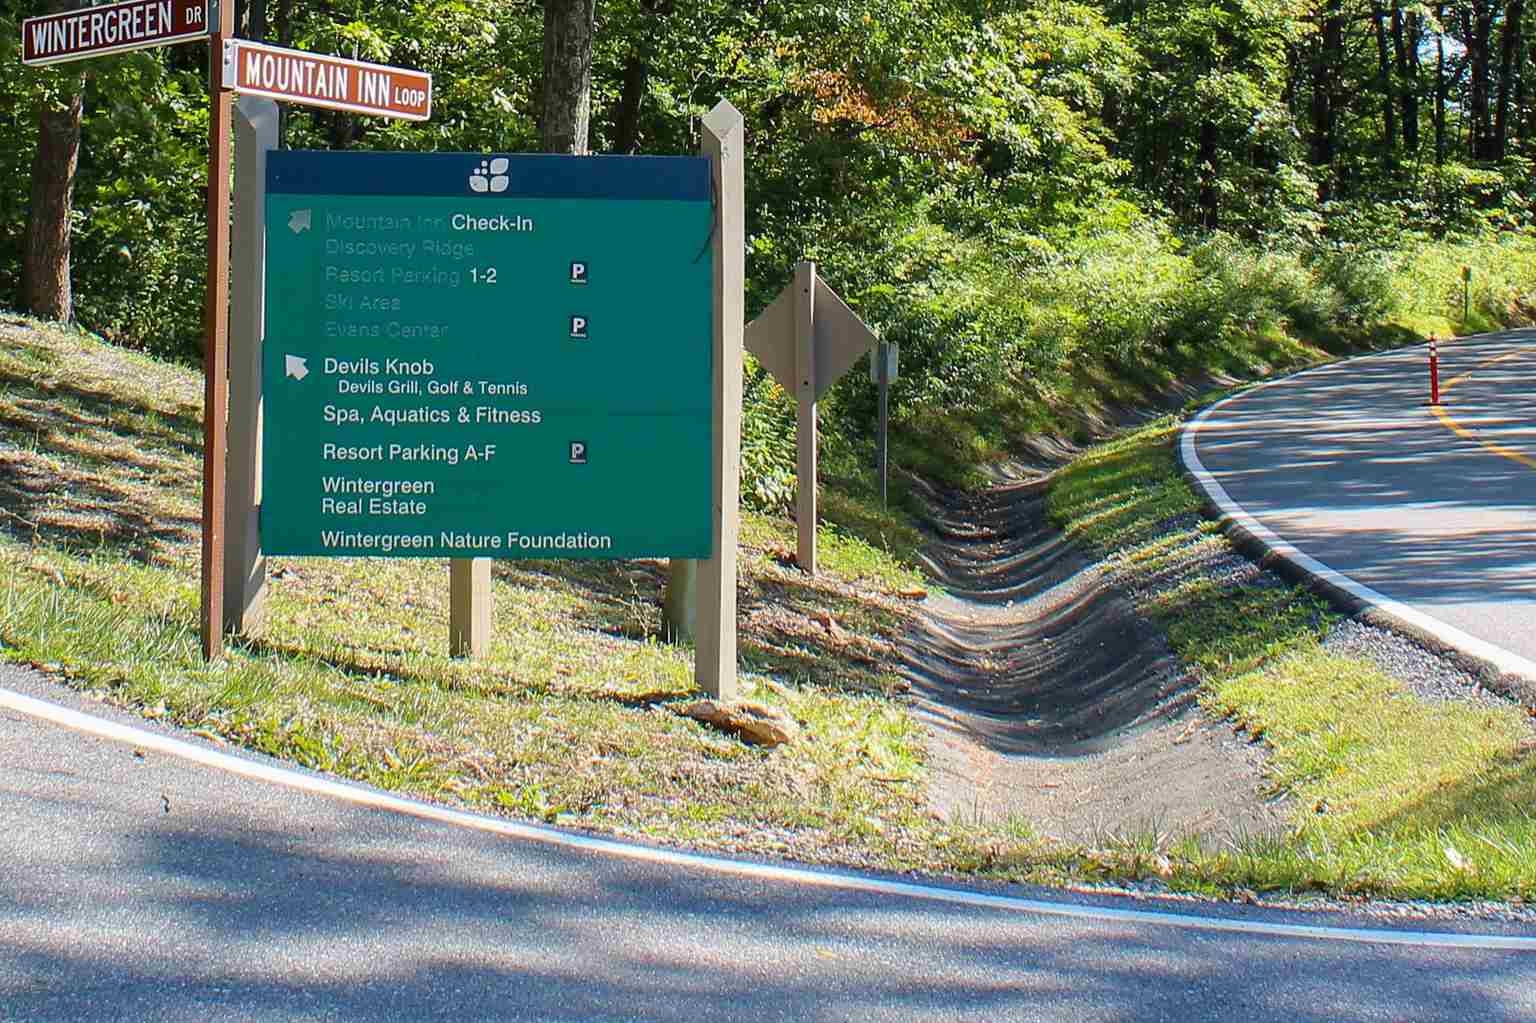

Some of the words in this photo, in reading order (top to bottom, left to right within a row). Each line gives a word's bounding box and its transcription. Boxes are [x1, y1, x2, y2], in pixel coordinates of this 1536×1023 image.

[31, 0, 172, 56] WINTERGREEN
[185, 6, 202, 25] DR
[245, 50, 348, 101] MOUNTAIN
[357, 69, 391, 107] INN
[393, 87, 426, 108] LOOP
[325, 213, 411, 231] Mountain
[416, 215, 444, 232] Inn
[450, 213, 534, 232] Check-In
[324, 238, 416, 258] Discovery
[421, 239, 475, 260] Ridge
[325, 266, 385, 283] Resort
[391, 267, 461, 287] Parking
[469, 267, 498, 284] 1-2
[324, 293, 353, 310] Ski
[359, 295, 401, 311] Area
[325, 321, 380, 337] Evans
[387, 321, 449, 338] Center
[324, 357, 380, 375] Devils
[384, 358, 434, 376] Knob
[338, 379, 384, 394] Devils
[388, 380, 423, 396] Grill,
[427, 380, 459, 395] Golf
[463, 381, 474, 395] &
[478, 381, 528, 396] Tennis
[323, 405, 365, 425] Spa,
[370, 406, 450, 426] Aquatics
[457, 407, 470, 423] &
[476, 407, 542, 424] Fitness
[323, 443, 383, 461] Resort
[389, 444, 459, 464] Parking
[464, 444, 497, 461] A-F
[322, 476, 435, 497] Wintergreen
[321, 498, 362, 514] Real
[368, 498, 427, 514] Estate
[321, 530, 434, 551] Wintergreen
[439, 531, 502, 549] Nature
[507, 531, 612, 549] Foundation
